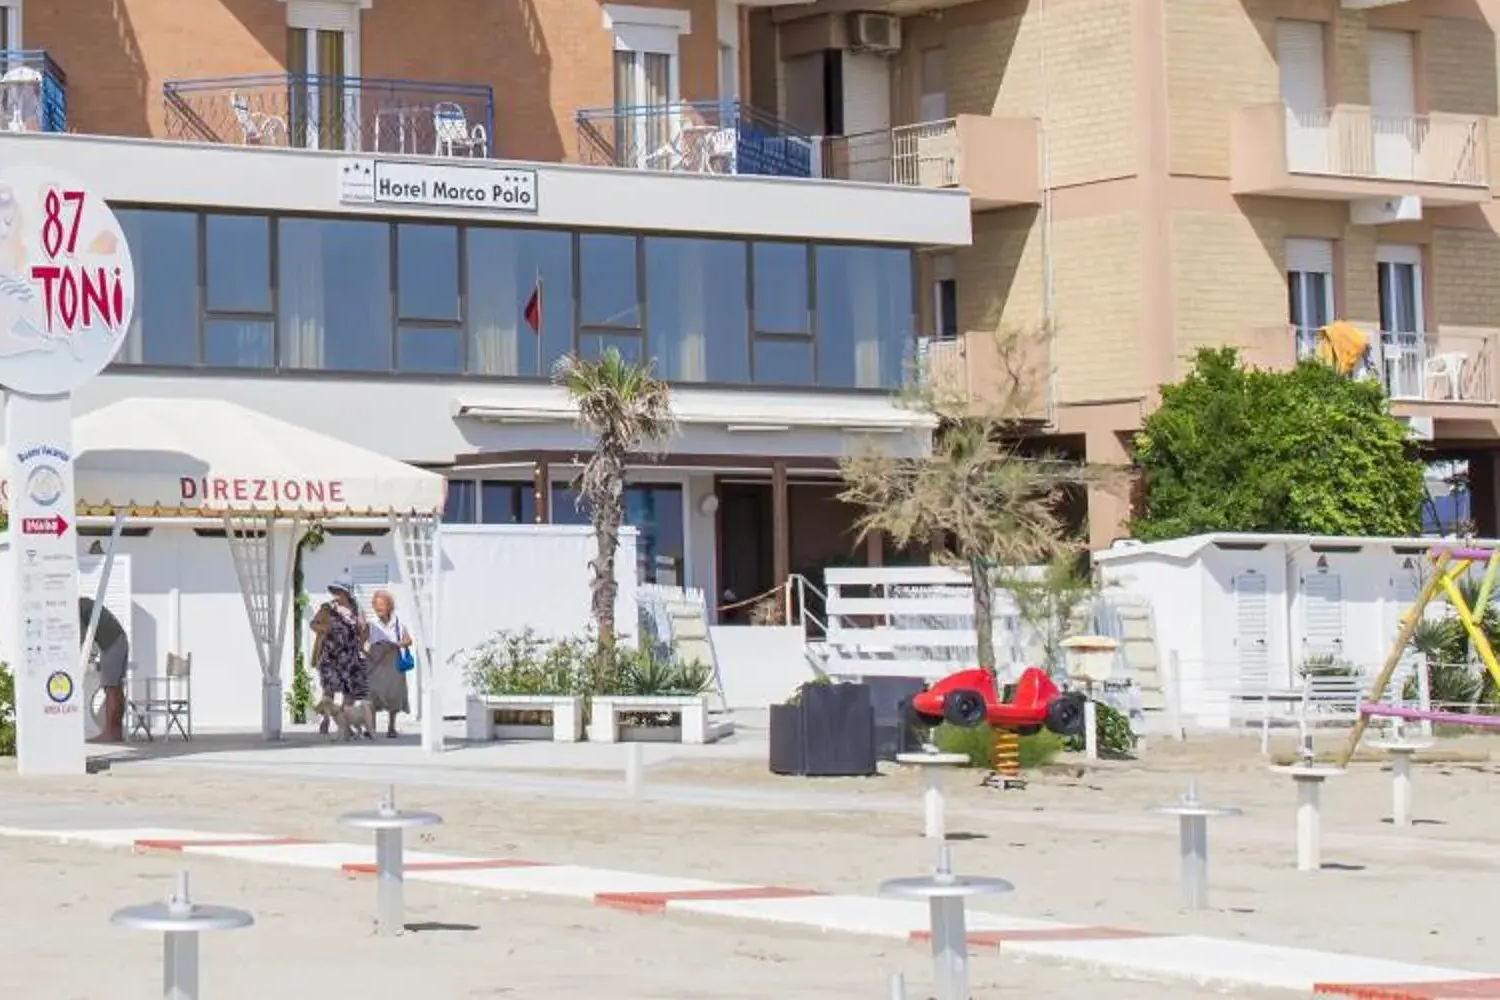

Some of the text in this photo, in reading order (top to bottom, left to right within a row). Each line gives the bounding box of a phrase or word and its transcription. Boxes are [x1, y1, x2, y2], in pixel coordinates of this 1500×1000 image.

[379, 178, 531, 204] Hotel Marco Polo
[43, 189, 86, 260] 87
[180, 476, 344, 503] DIREZIONE
